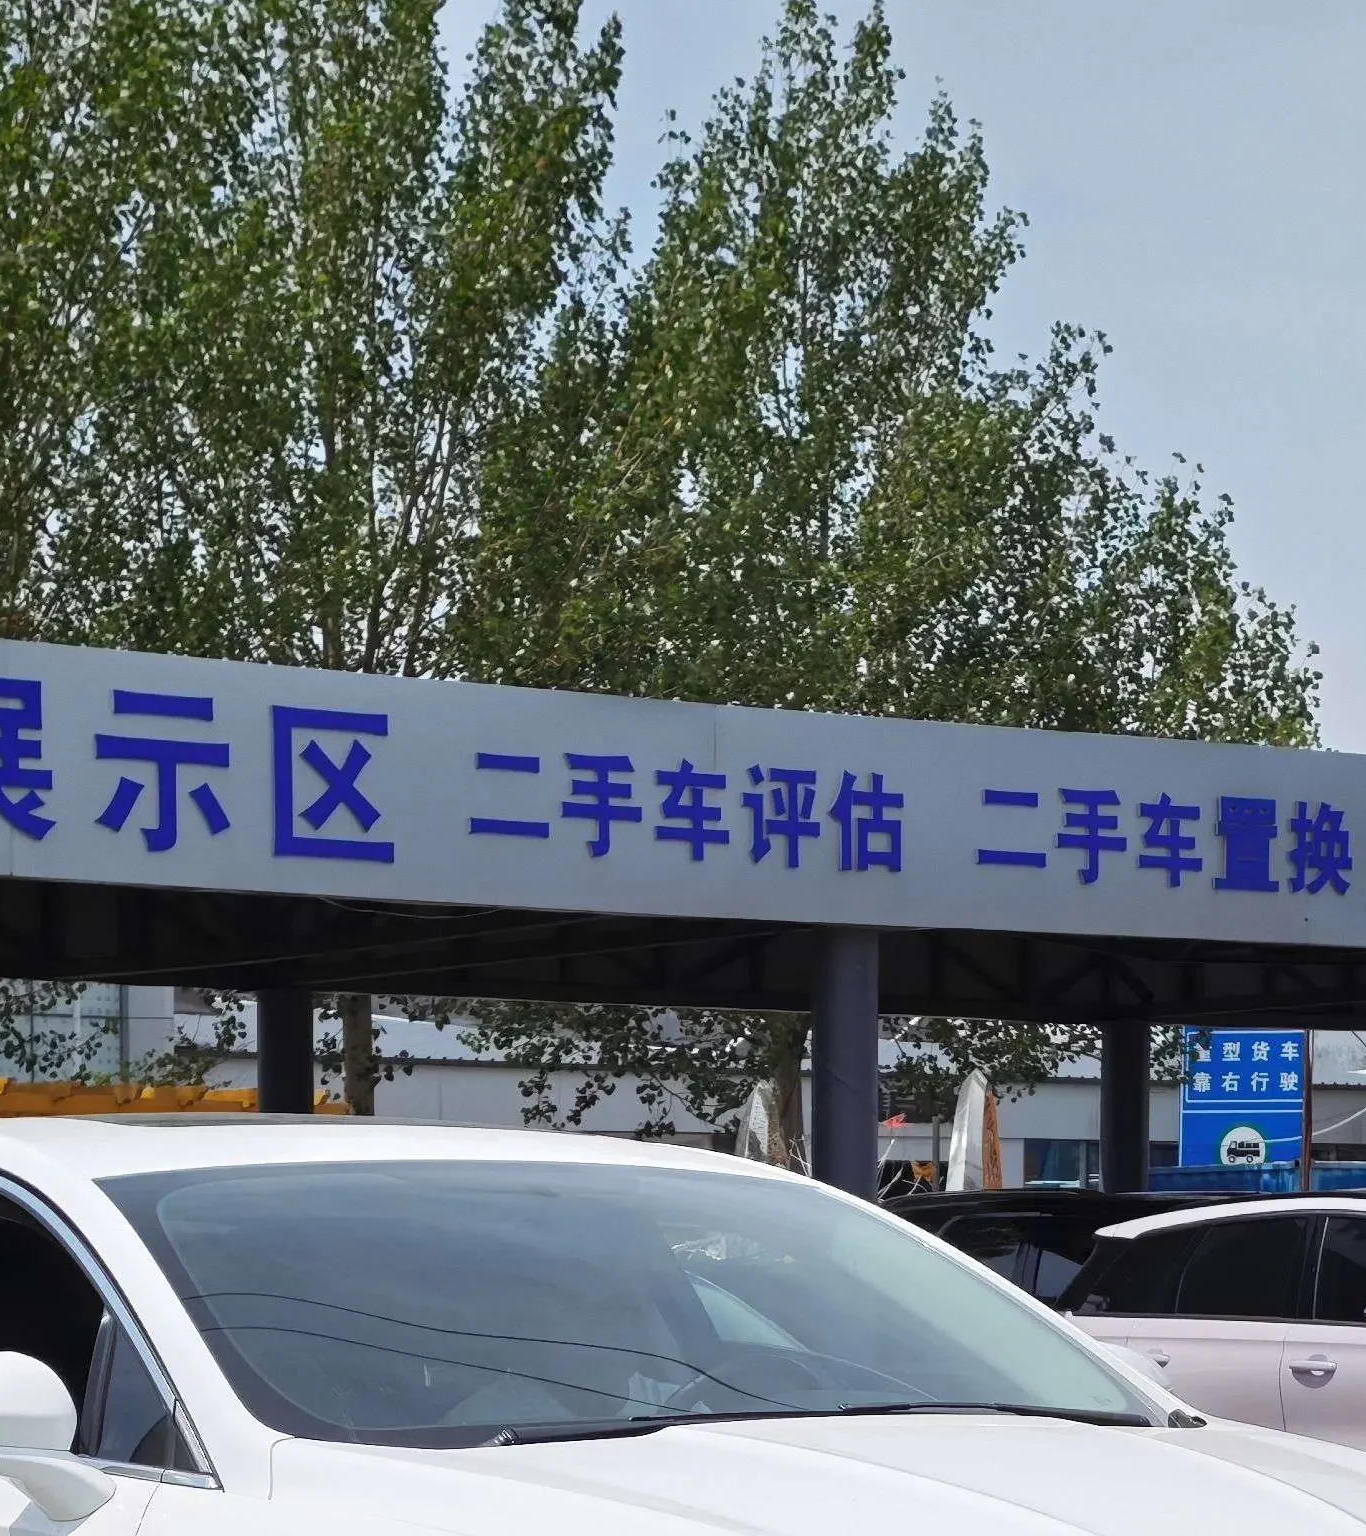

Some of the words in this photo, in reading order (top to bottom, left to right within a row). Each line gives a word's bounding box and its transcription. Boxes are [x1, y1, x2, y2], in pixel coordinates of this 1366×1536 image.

[469, 751, 905, 873] 二手车评估
[977, 787, 1353, 893] 二手车置换
[1192, 1071, 1299, 1093] 靠右行驶
